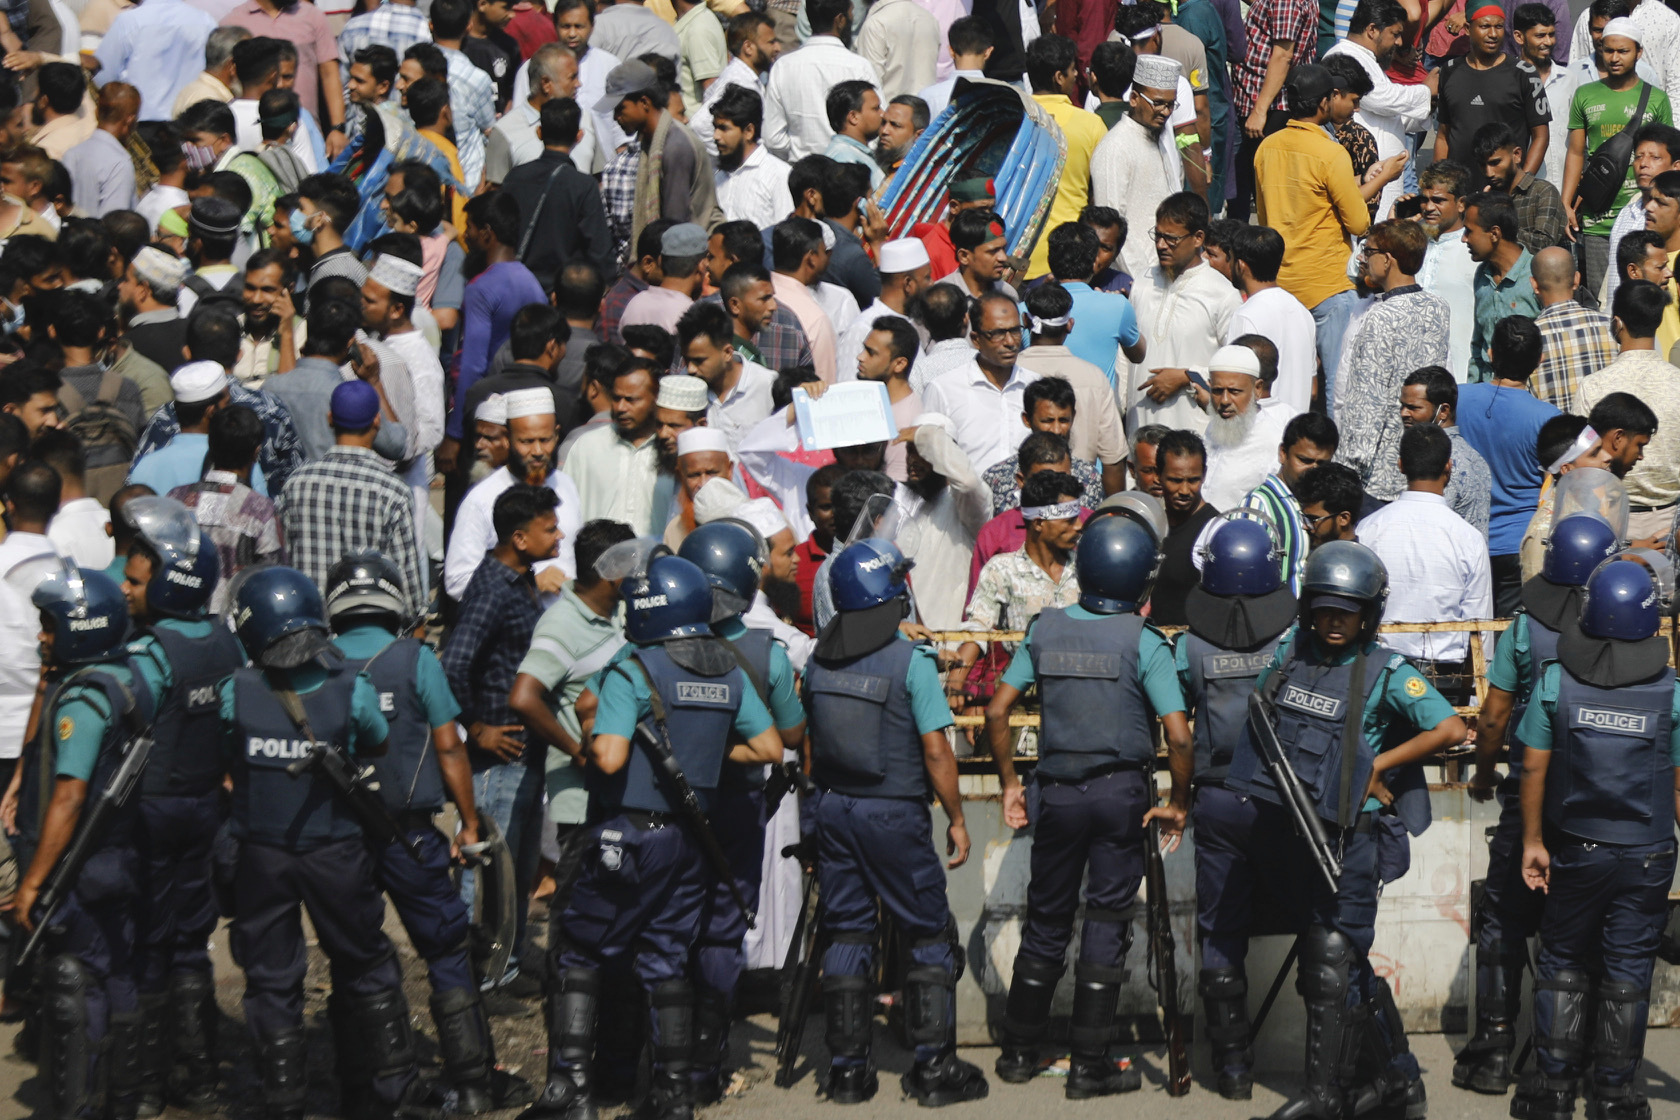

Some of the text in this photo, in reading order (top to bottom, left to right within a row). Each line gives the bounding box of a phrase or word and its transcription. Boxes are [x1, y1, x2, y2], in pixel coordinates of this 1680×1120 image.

[167, 570, 202, 589] POLICE
[634, 594, 668, 610] POLICE
[70, 616, 109, 631] POLICE
[1220, 657, 1269, 669] POLICE
[188, 685, 216, 708] POL
[682, 686, 724, 700] POLICE
[1288, 689, 1334, 714] POLICE
[1585, 712, 1639, 729] POLICE
[249, 737, 314, 759] POLIC
